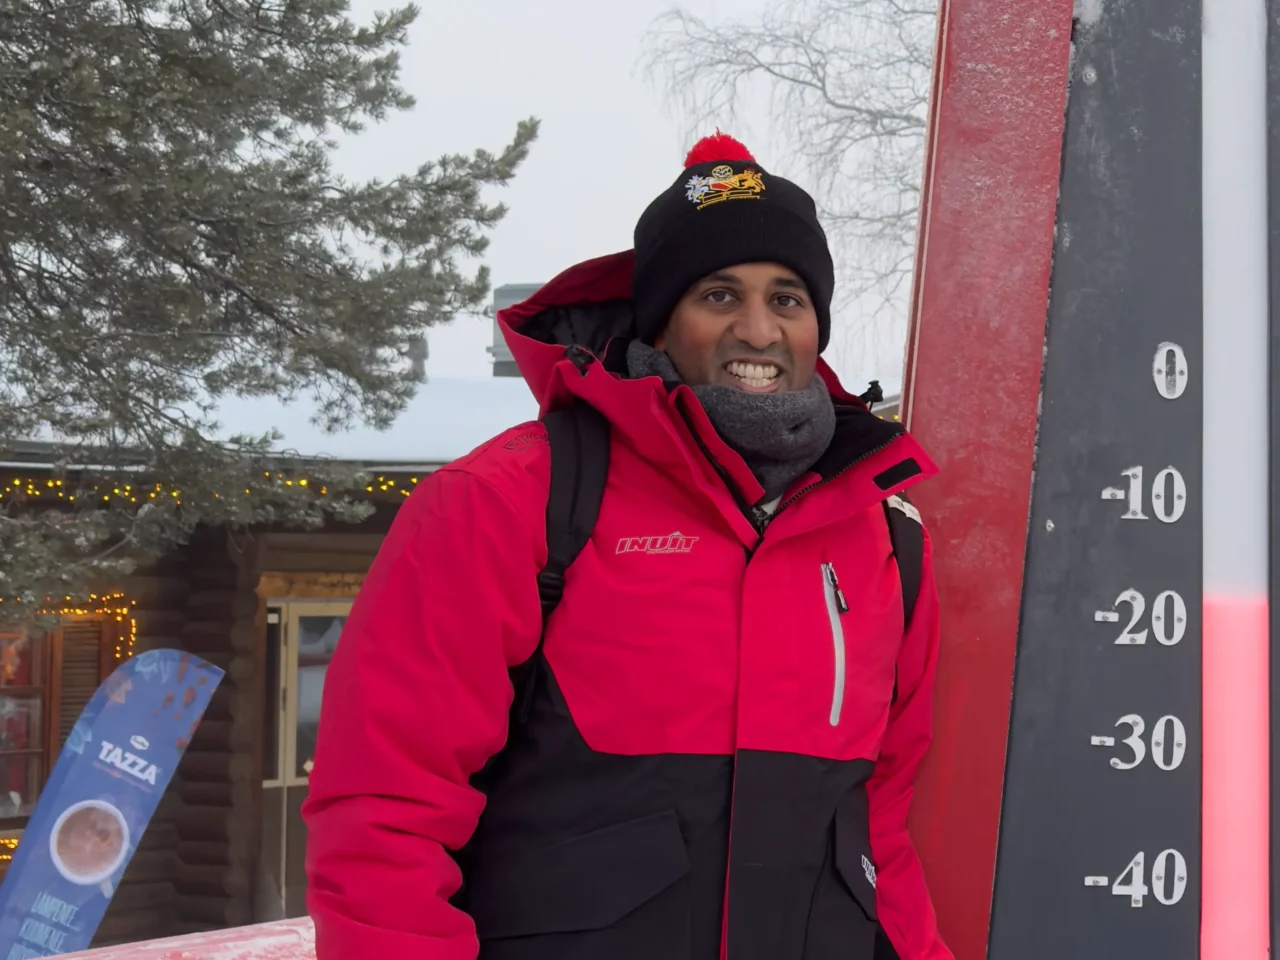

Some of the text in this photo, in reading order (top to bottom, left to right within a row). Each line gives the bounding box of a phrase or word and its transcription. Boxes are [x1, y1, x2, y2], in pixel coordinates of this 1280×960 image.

[1152, 343, 1188, 399] 0
[1101, 465, 1187, 523] -10
[615, 532, 700, 555] INUIT
[1094, 588, 1187, 646] -20
[98, 740, 156, 786] TAZZA
[1090, 713, 1187, 771] -30
[1084, 848, 1188, 907] -40
